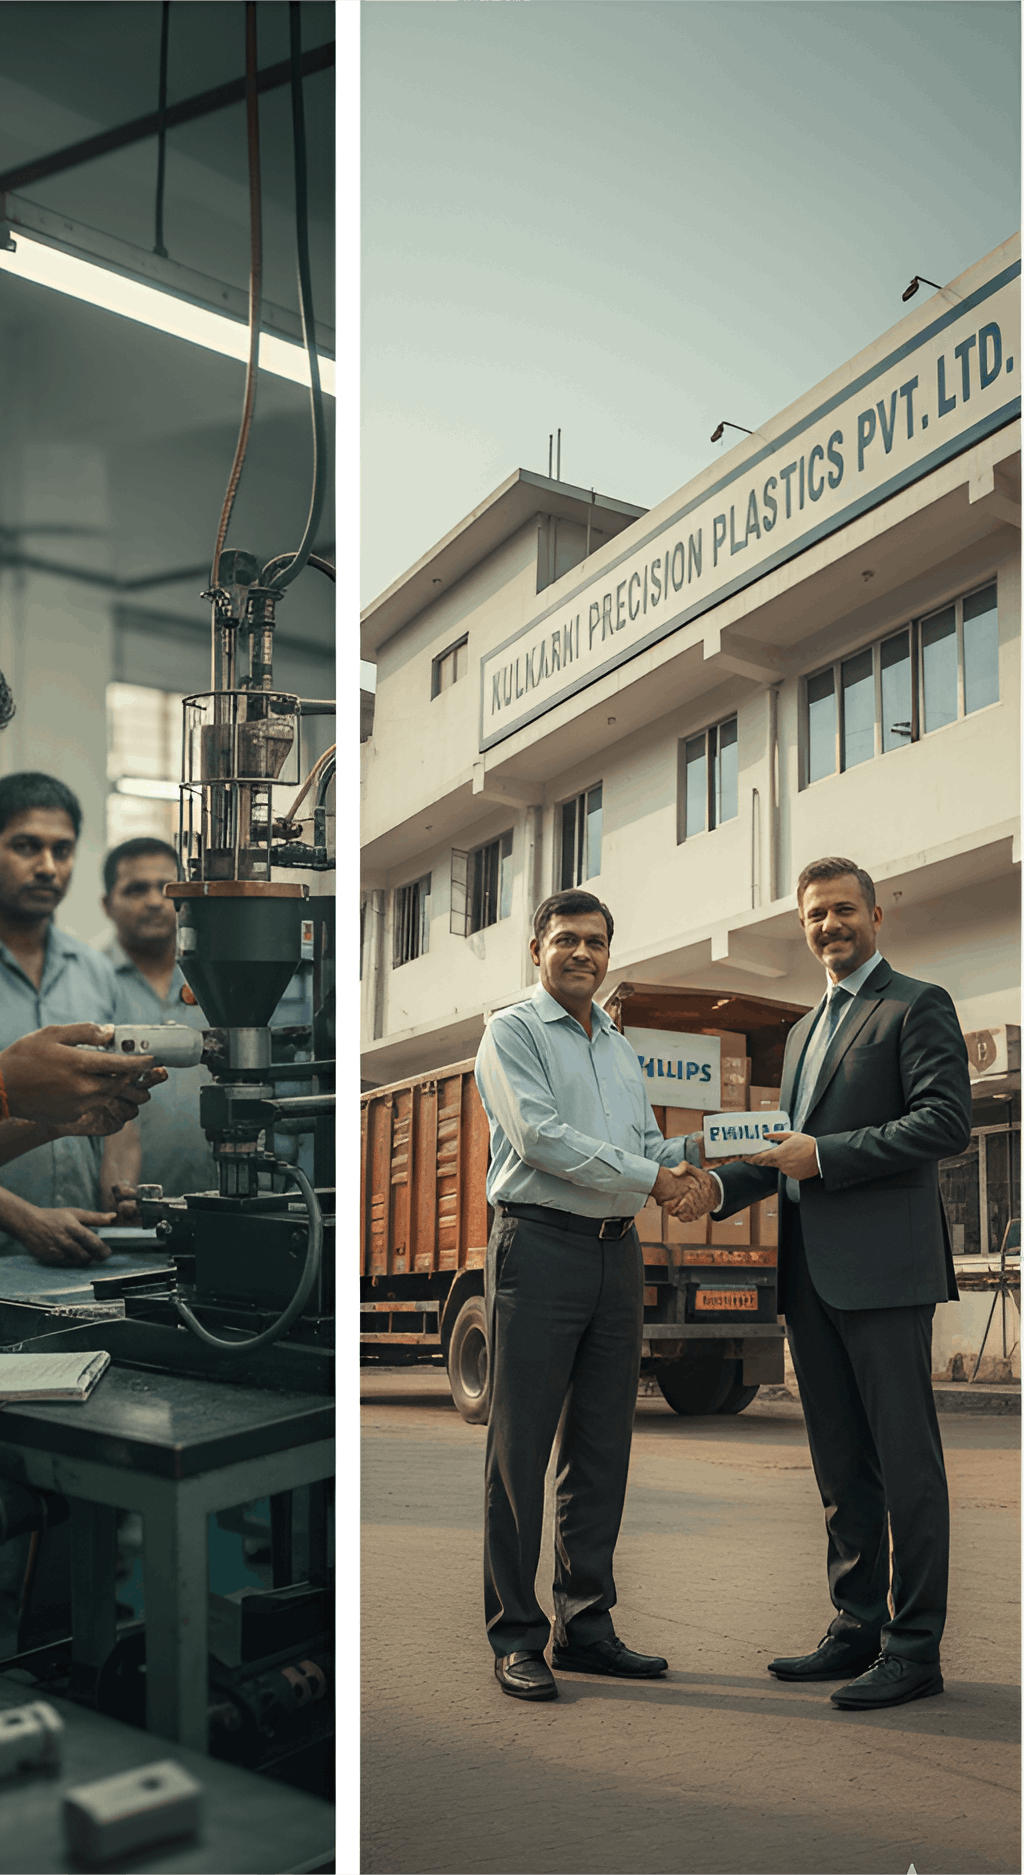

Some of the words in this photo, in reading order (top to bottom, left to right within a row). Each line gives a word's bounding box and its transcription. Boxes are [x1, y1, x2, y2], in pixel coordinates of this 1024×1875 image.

[589, 528, 703, 651] PRECISION
[713, 429, 845, 568] PLASTICS
[857, 374, 929, 473] PVT.
[937, 321, 1014, 419] LTD.
[637, 1055, 712, 1082] HILIPS
